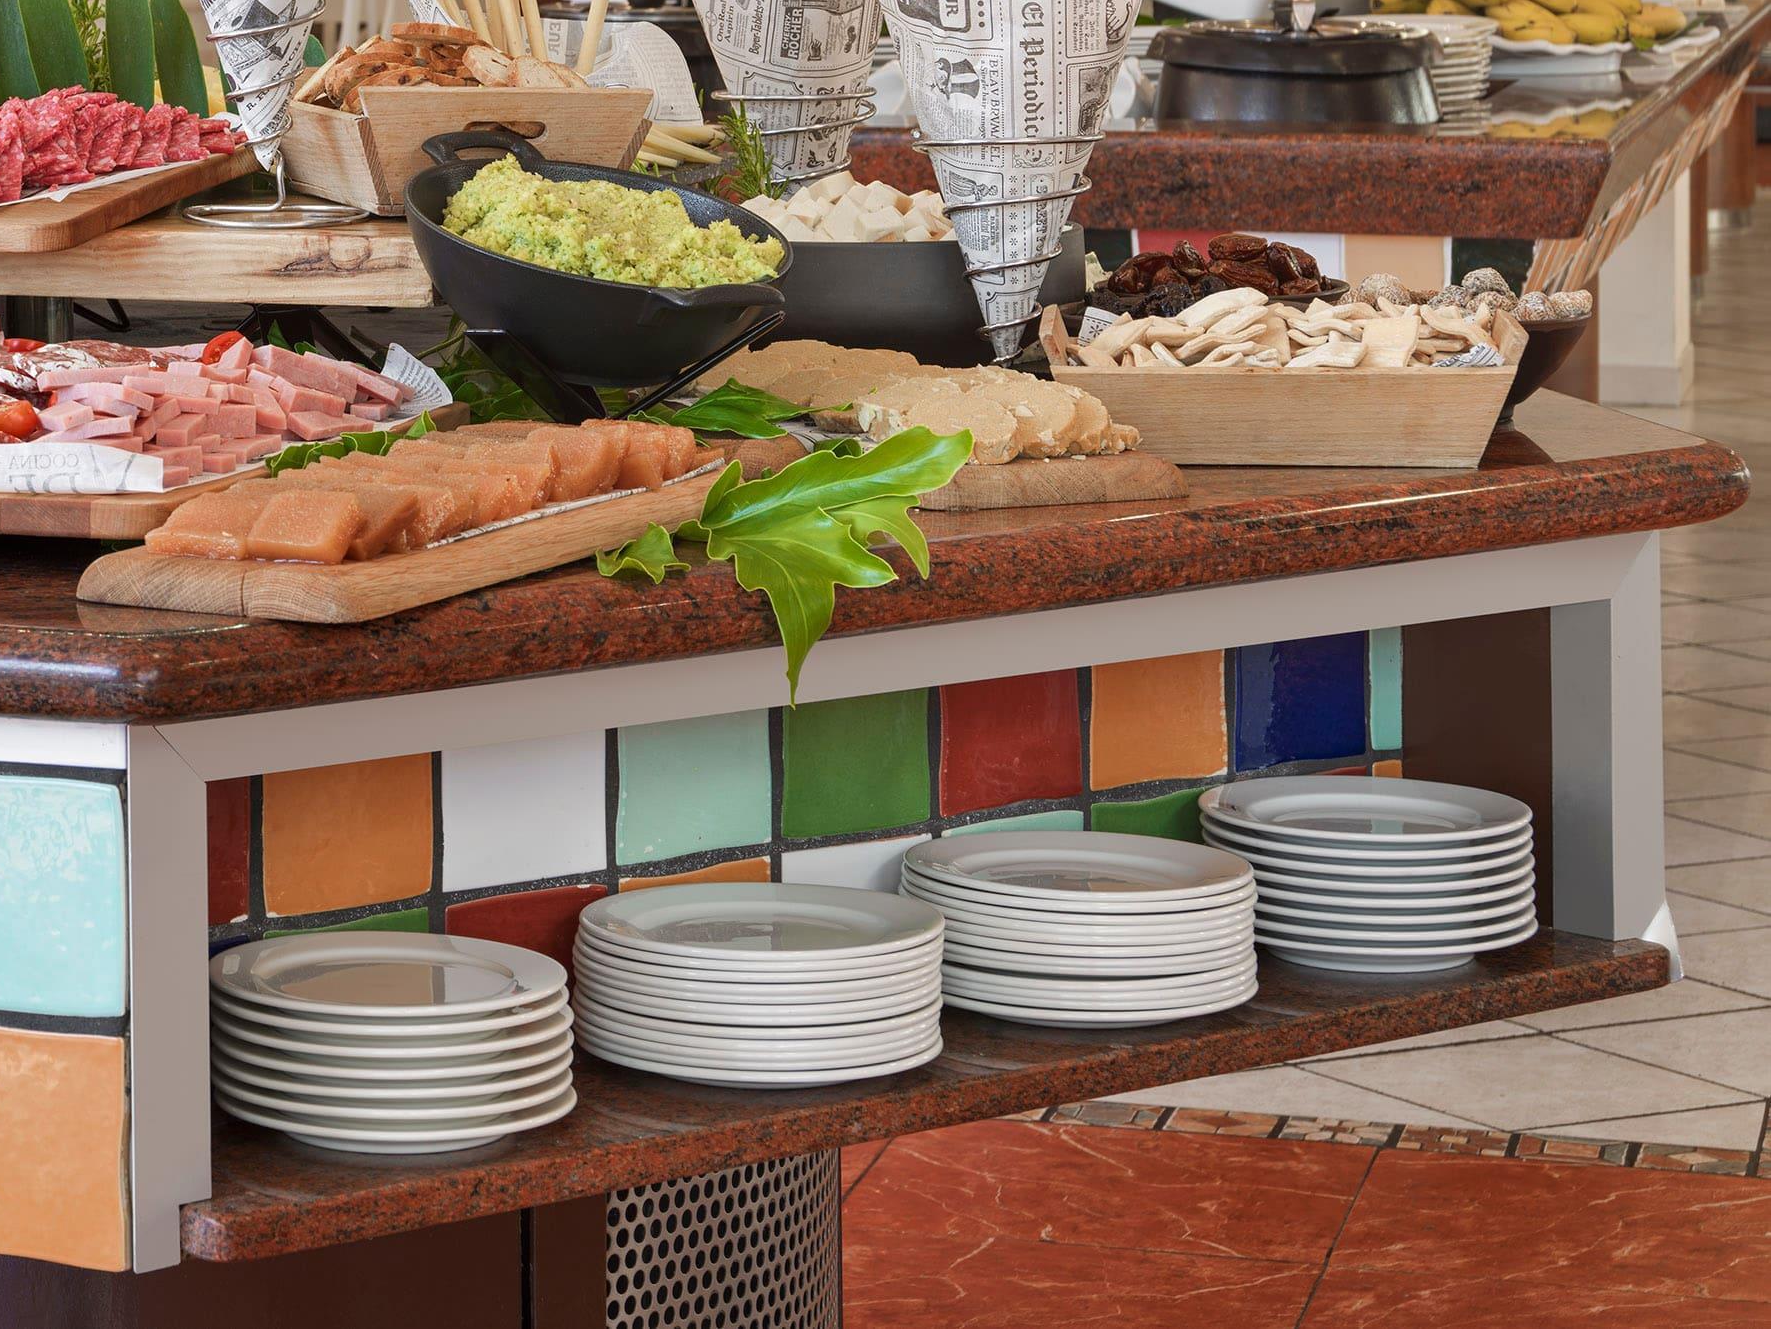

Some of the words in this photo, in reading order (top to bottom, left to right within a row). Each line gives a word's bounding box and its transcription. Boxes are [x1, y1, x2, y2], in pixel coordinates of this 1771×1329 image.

[718, 0, 727, 21] Real
[724, 5, 734, 43] Aspirin
[1021, 1, 1045, 28] El
[716, 23, 725, 42] One
[787, 8, 804, 60] ROCHER
[979, 66, 988, 91] Single
[980, 90, 988, 110] hair
[978, 110, 986, 139] annoye
[1035, 185, 1048, 234] SREET
